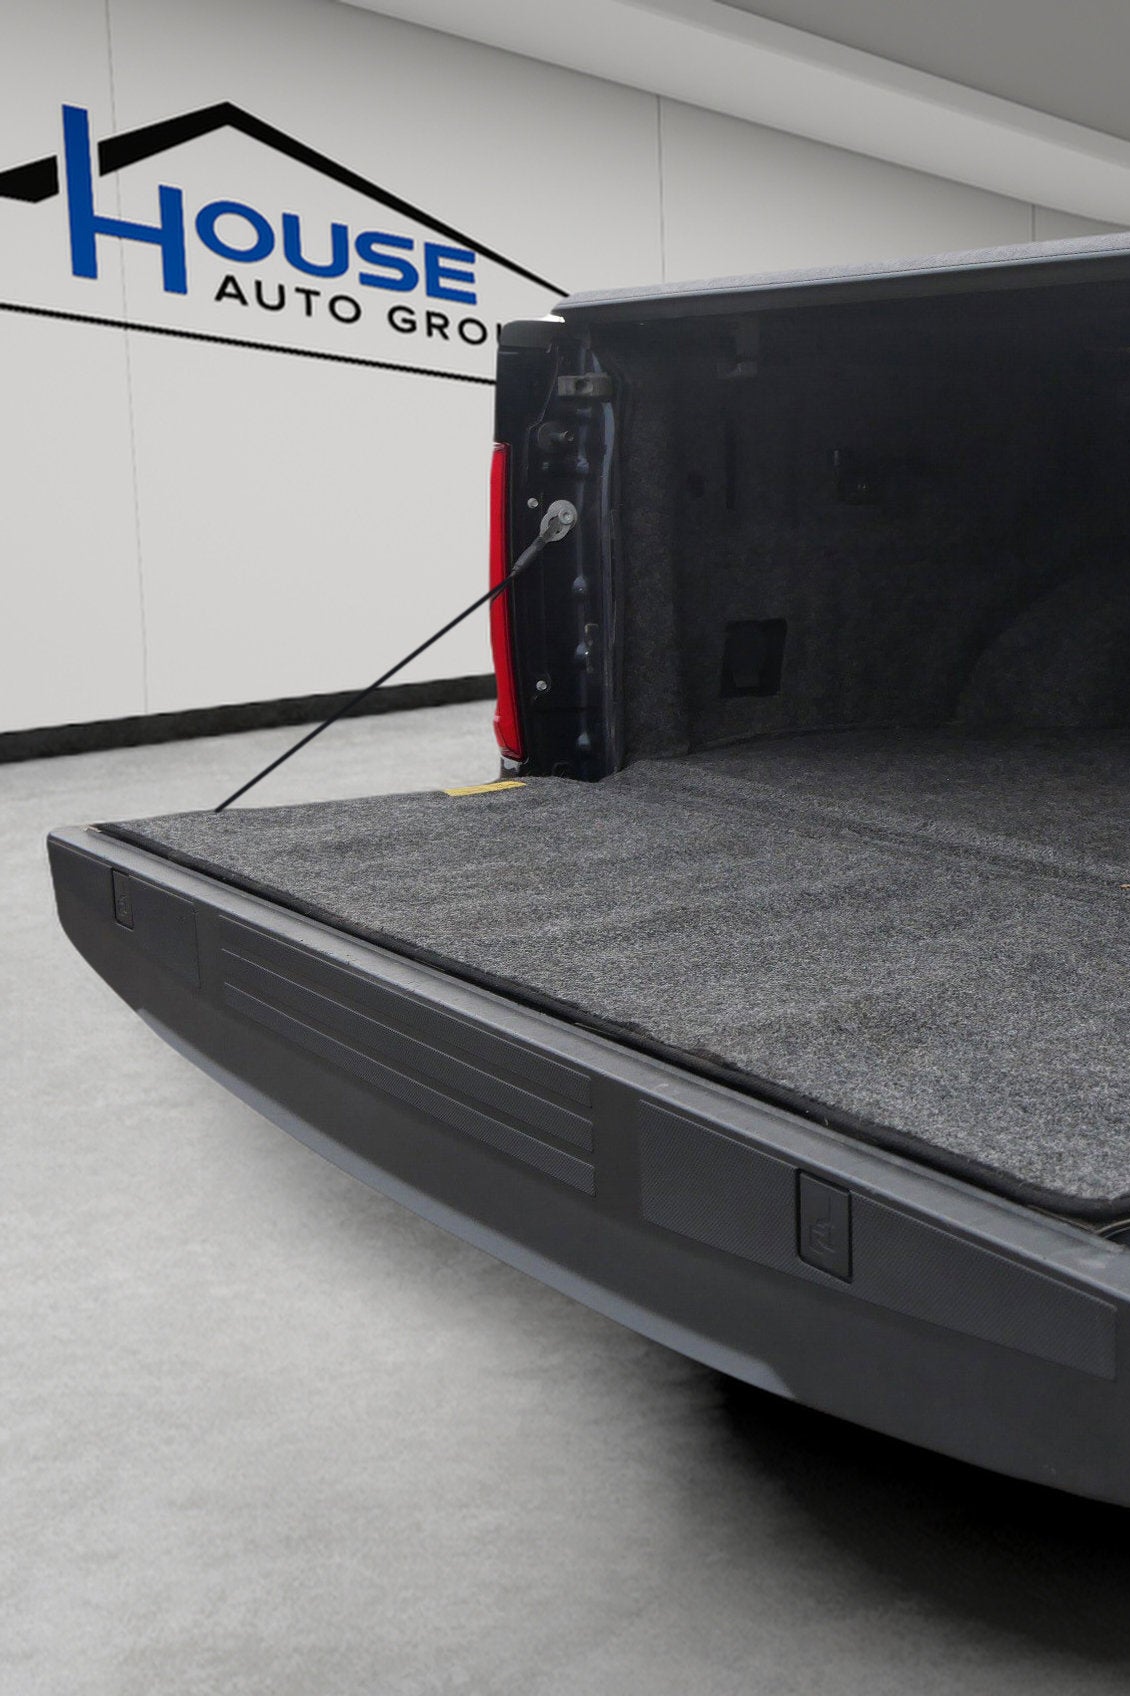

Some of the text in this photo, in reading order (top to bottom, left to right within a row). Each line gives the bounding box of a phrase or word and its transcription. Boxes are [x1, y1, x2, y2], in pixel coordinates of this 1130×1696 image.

[62, 104, 477, 305] HOUSE
[214, 274, 501, 346] AUTO GRO
